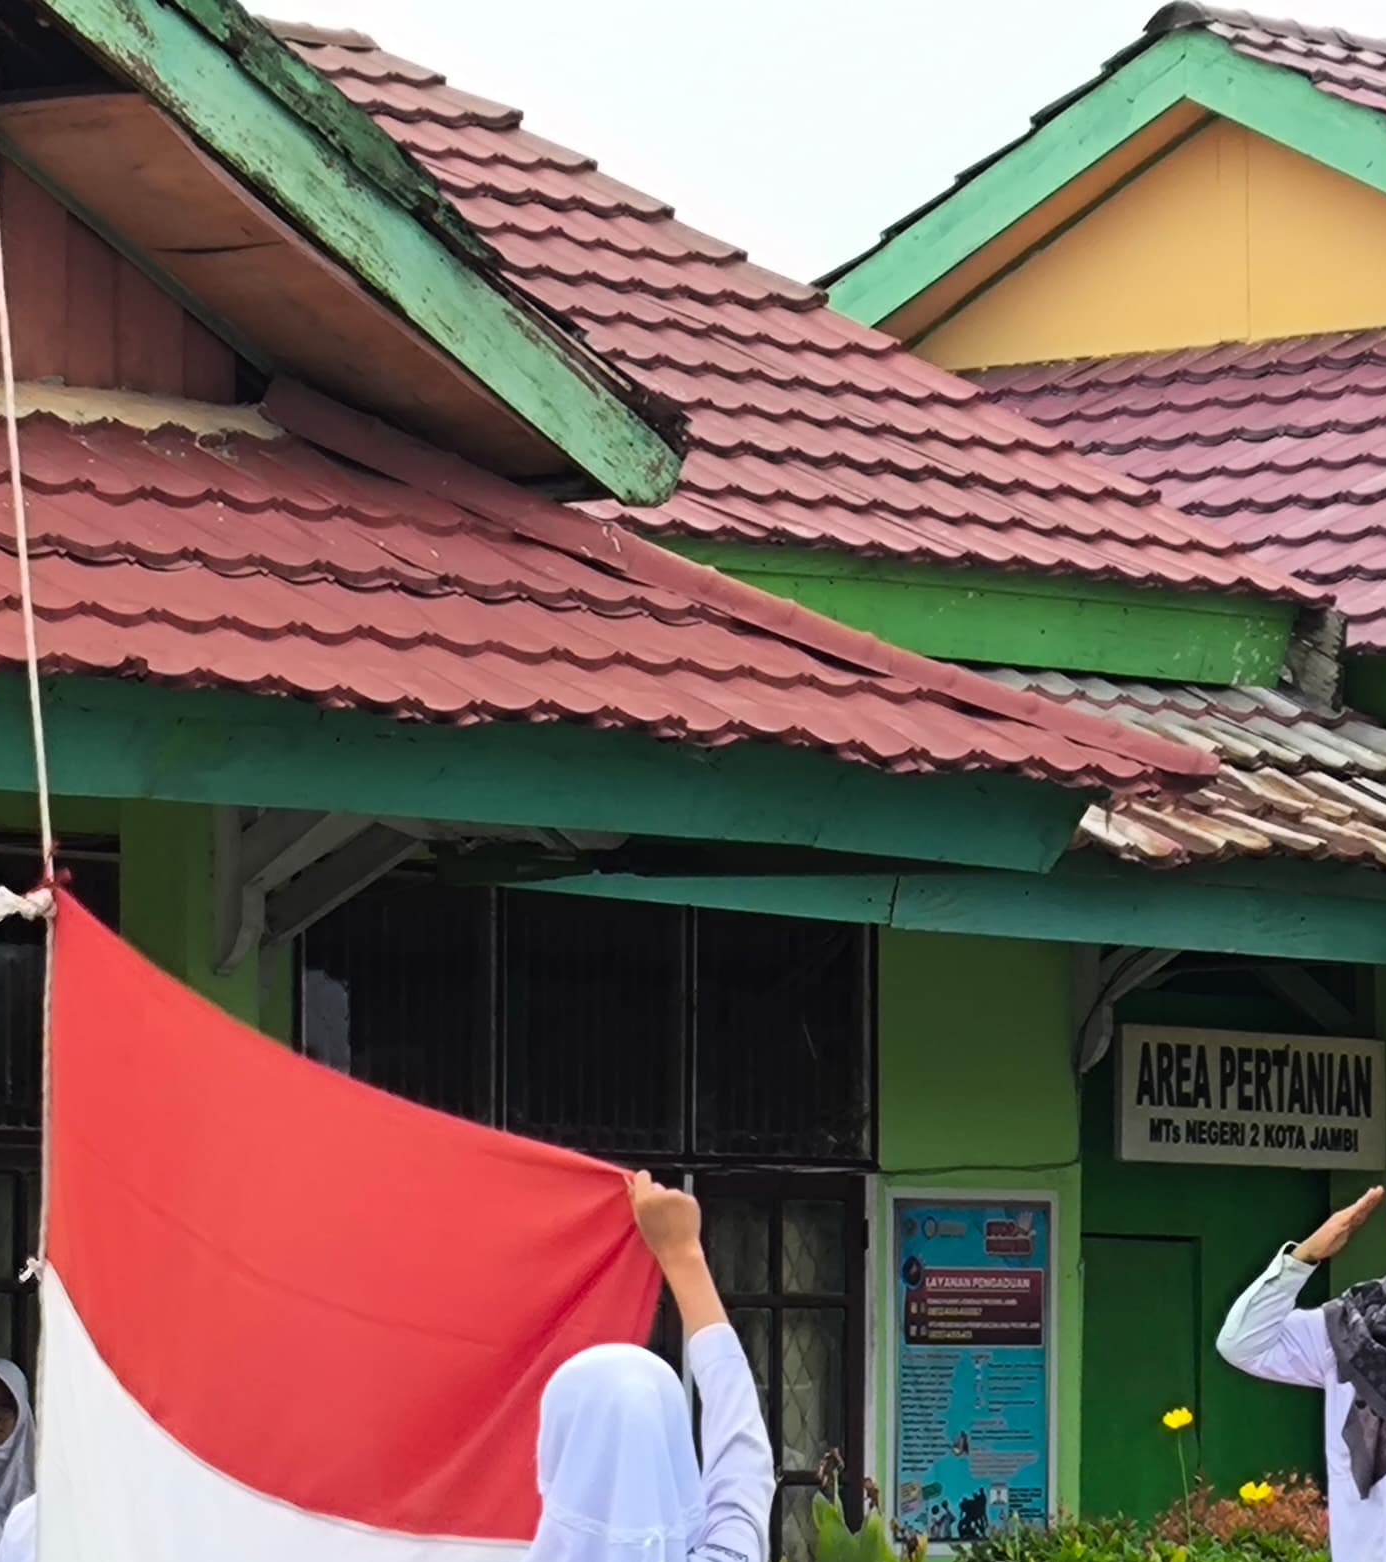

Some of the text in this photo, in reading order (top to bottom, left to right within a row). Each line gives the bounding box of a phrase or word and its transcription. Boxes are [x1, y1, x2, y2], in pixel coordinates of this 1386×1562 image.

[1136, 1041, 1372, 1118] AREA PERTANIAN
[1149, 1117, 1359, 1152] MTs NEGERI 2 KOTA JAMBI
